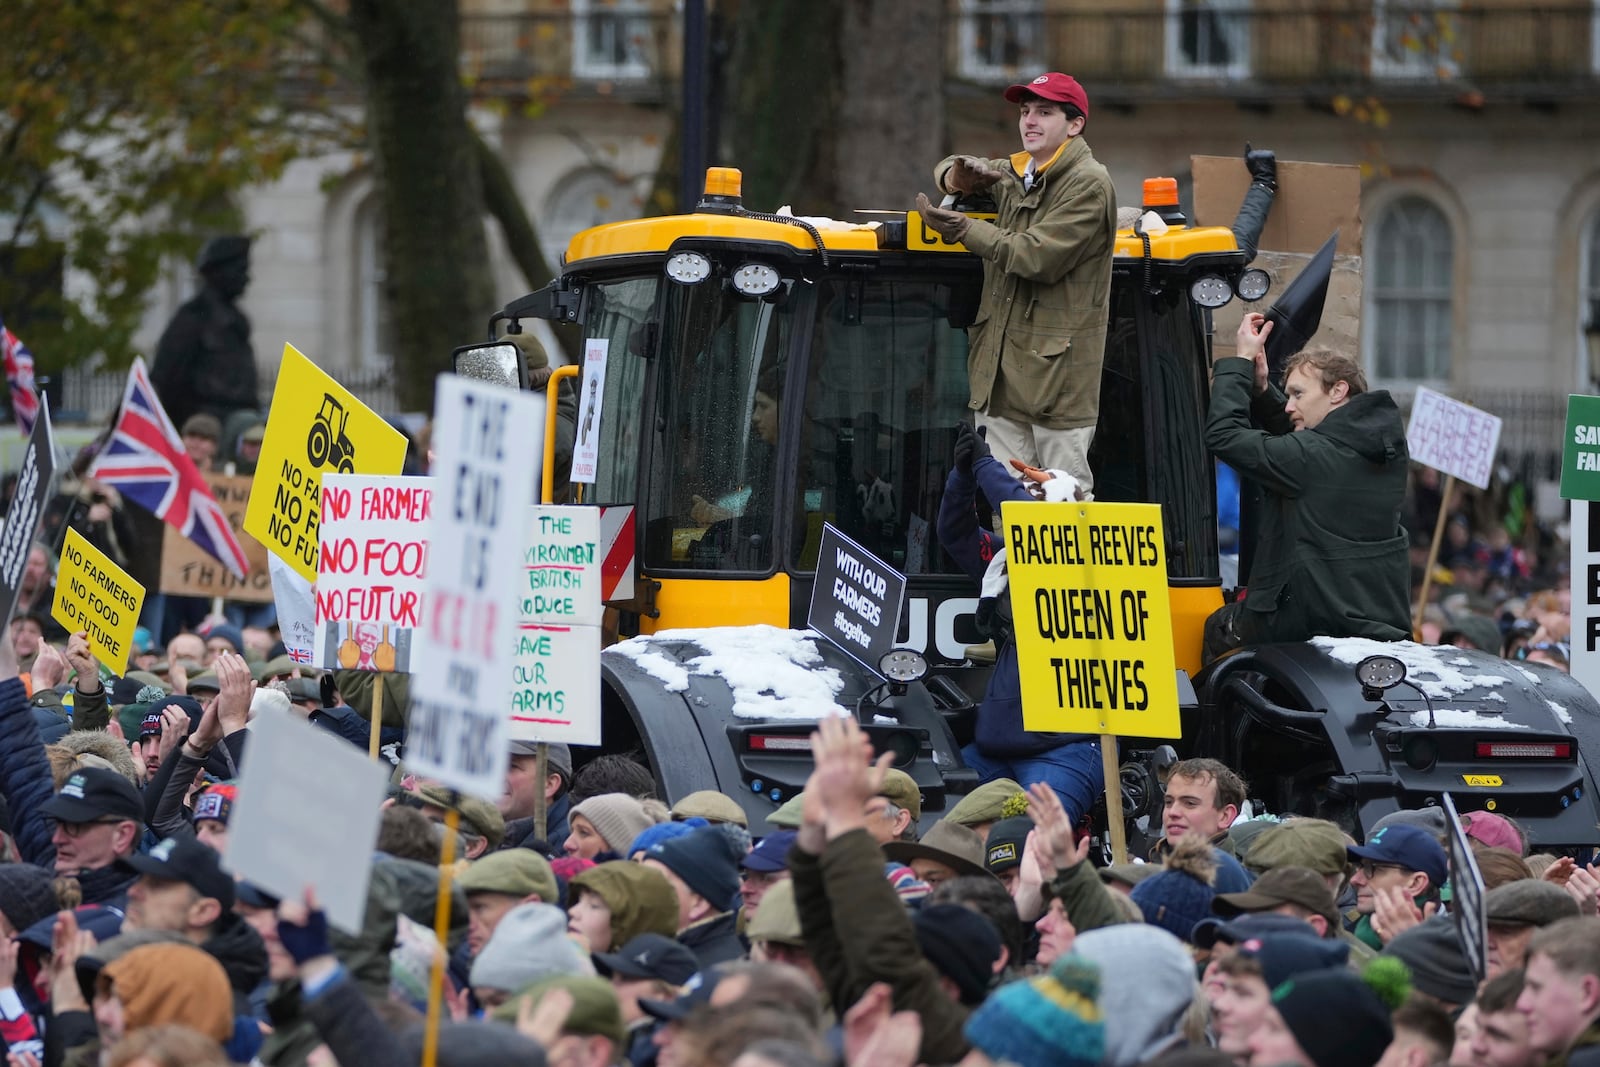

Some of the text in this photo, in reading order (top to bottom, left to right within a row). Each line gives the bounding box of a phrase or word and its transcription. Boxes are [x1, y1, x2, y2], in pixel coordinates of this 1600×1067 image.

[274, 483, 301, 525] NO
[281, 458, 321, 508] NO FA
[321, 486, 351, 524] NO
[538, 515, 572, 535] THE
[268, 512, 292, 548] NO
[1010, 524, 1158, 567] RACHEL REEVES
[319, 538, 358, 574] NO
[835, 546, 887, 601] WITH OUR
[65, 544, 137, 612] NO FARMERS
[529, 569, 581, 590] BRITISH
[70, 576, 119, 627] NO FOOD
[315, 588, 344, 626] NO
[832, 577, 882, 627] FARMERS
[1034, 588, 1149, 644] QUEEN OF
[60, 595, 120, 657] NO FUTURE
[833, 610, 872, 649] #together
[512, 662, 547, 685] OUR
[1050, 657, 1149, 711] THIEVES
[510, 689, 565, 714] ARMS
